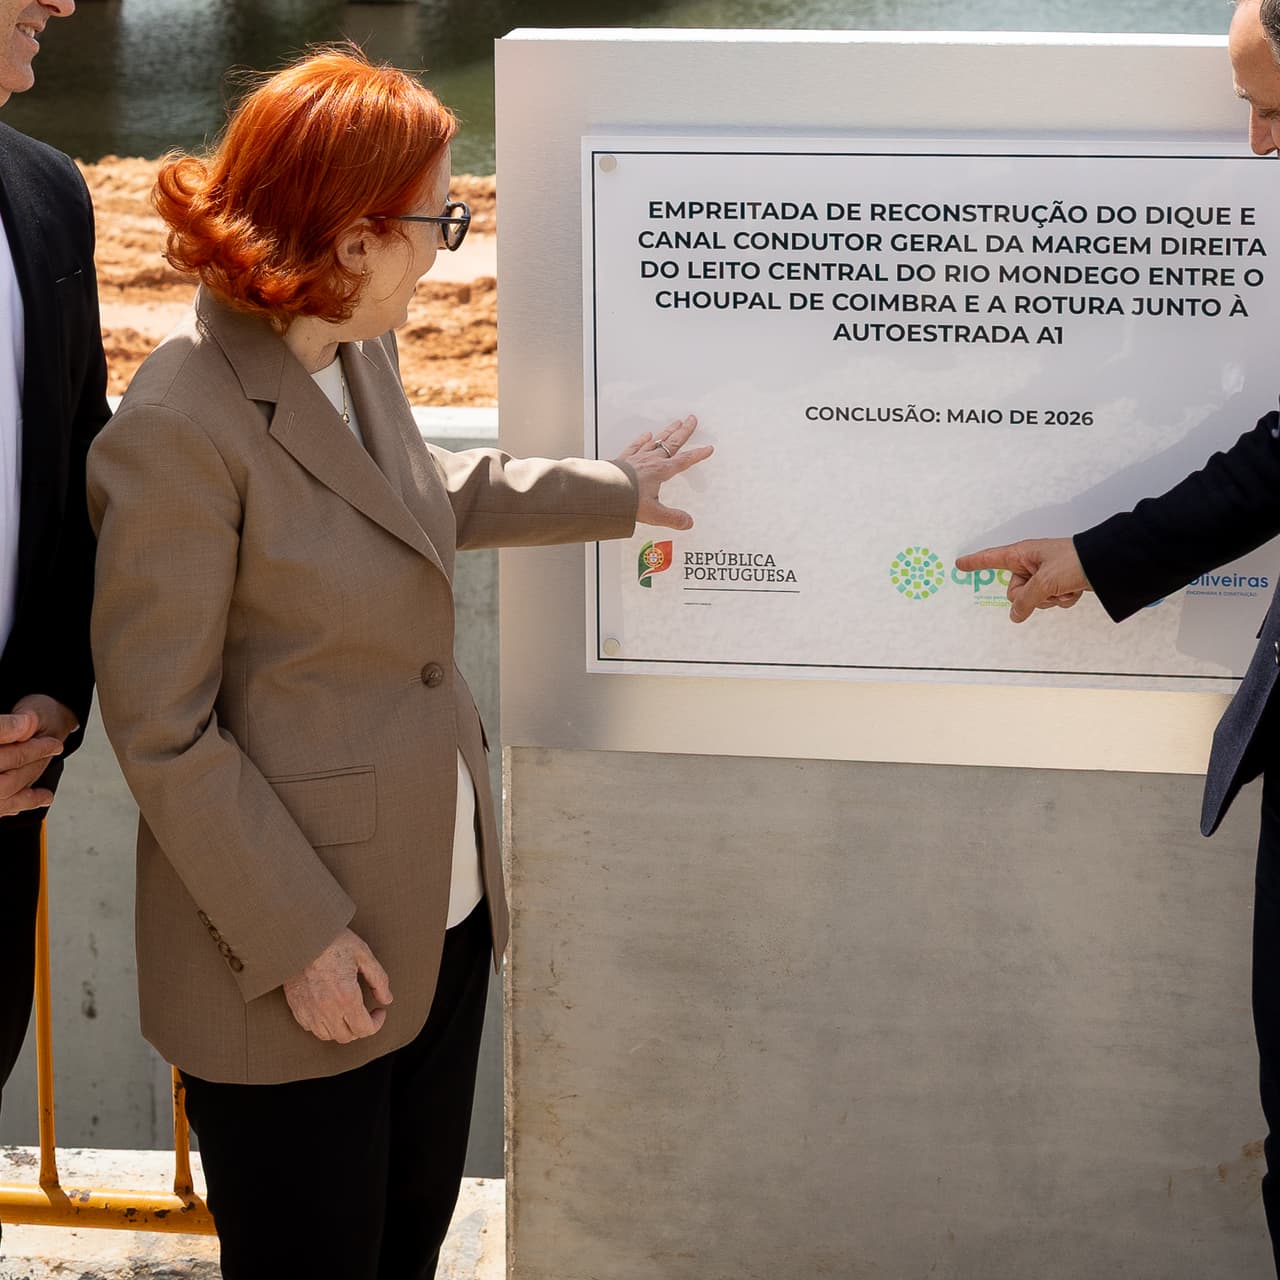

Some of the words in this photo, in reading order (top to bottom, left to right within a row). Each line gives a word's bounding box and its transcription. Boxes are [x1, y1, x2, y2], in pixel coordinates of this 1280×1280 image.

[648, 200, 820, 221] EMPREITADA
[826, 202, 862, 222] DE
[870, 199, 1088, 230] RECONSTRUÇÃO
[1096, 205, 1138, 225] DO
[1145, 205, 1232, 229] DIQUE
[1240, 207, 1256, 226] E
[637, 230, 727, 250] CANAL
[732, 231, 883, 252] CONDUTOR
[890, 233, 979, 253] GERAL
[985, 234, 1025, 254] DA
[1032, 234, 1152, 256] MARGEM
[1160, 236, 1268, 257] DIREITA
[640, 260, 680, 280] DO
[687, 260, 761, 281] LEITO
[767, 261, 889, 282] CENTRAL
[896, 263, 937, 283] DO
[944, 264, 991, 284] RIO
[998, 264, 1141, 286] MONDEGO
[1148, 266, 1236, 287] ENTRE
[1243, 268, 1265, 288] O
[655, 290, 782, 311] CHOUPAL
[789, 292, 825, 311] DE
[831, 292, 958, 313] COIMBRA
[964, 294, 980, 313] E
[986, 295, 1007, 314] A
[1014, 295, 1125, 316] ROTURA
[1130, 297, 1222, 318] JUNTO
[1228, 293, 1249, 318] À
[832, 322, 1031, 345] AUTOESTRADA
[1035, 325, 1064, 345] A1
[804, 403, 941, 424] CONCLUSÃO:
[947, 408, 1004, 425] MAIO
[1009, 409, 1039, 425] DE
[1043, 410, 1094, 427] 2026
[683, 549, 777, 570] REPÚBLICA
[683, 566, 798, 583] PORTUGUESA
